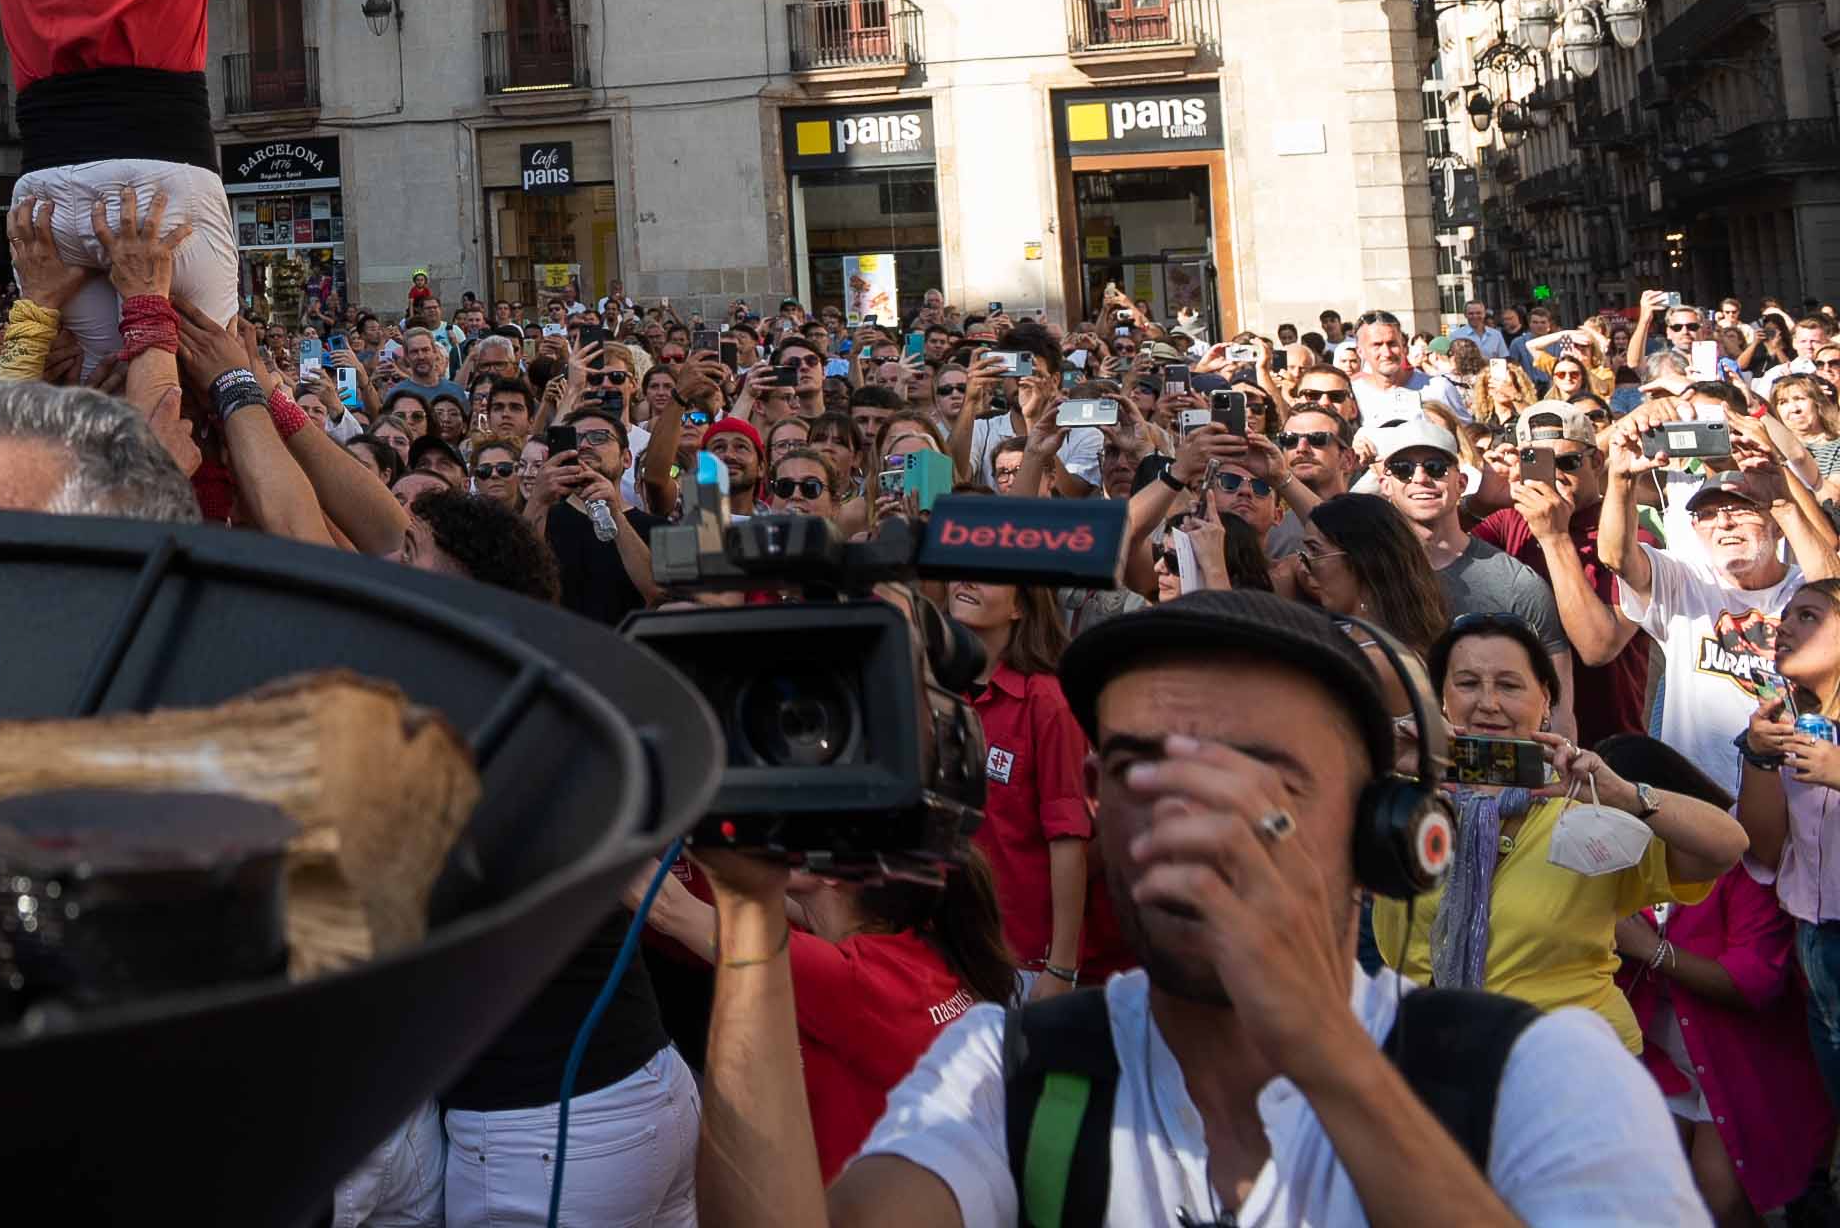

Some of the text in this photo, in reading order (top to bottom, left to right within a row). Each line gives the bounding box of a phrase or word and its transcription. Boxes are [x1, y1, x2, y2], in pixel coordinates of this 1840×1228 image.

[836, 114, 921, 153] pans
[1111, 98, 1207, 139] pans
[1170, 124, 1207, 138] COMPANY
[238, 143, 325, 176] BARCELONA
[523, 167, 569, 190] pans
[939, 519, 1095, 552] betevé
